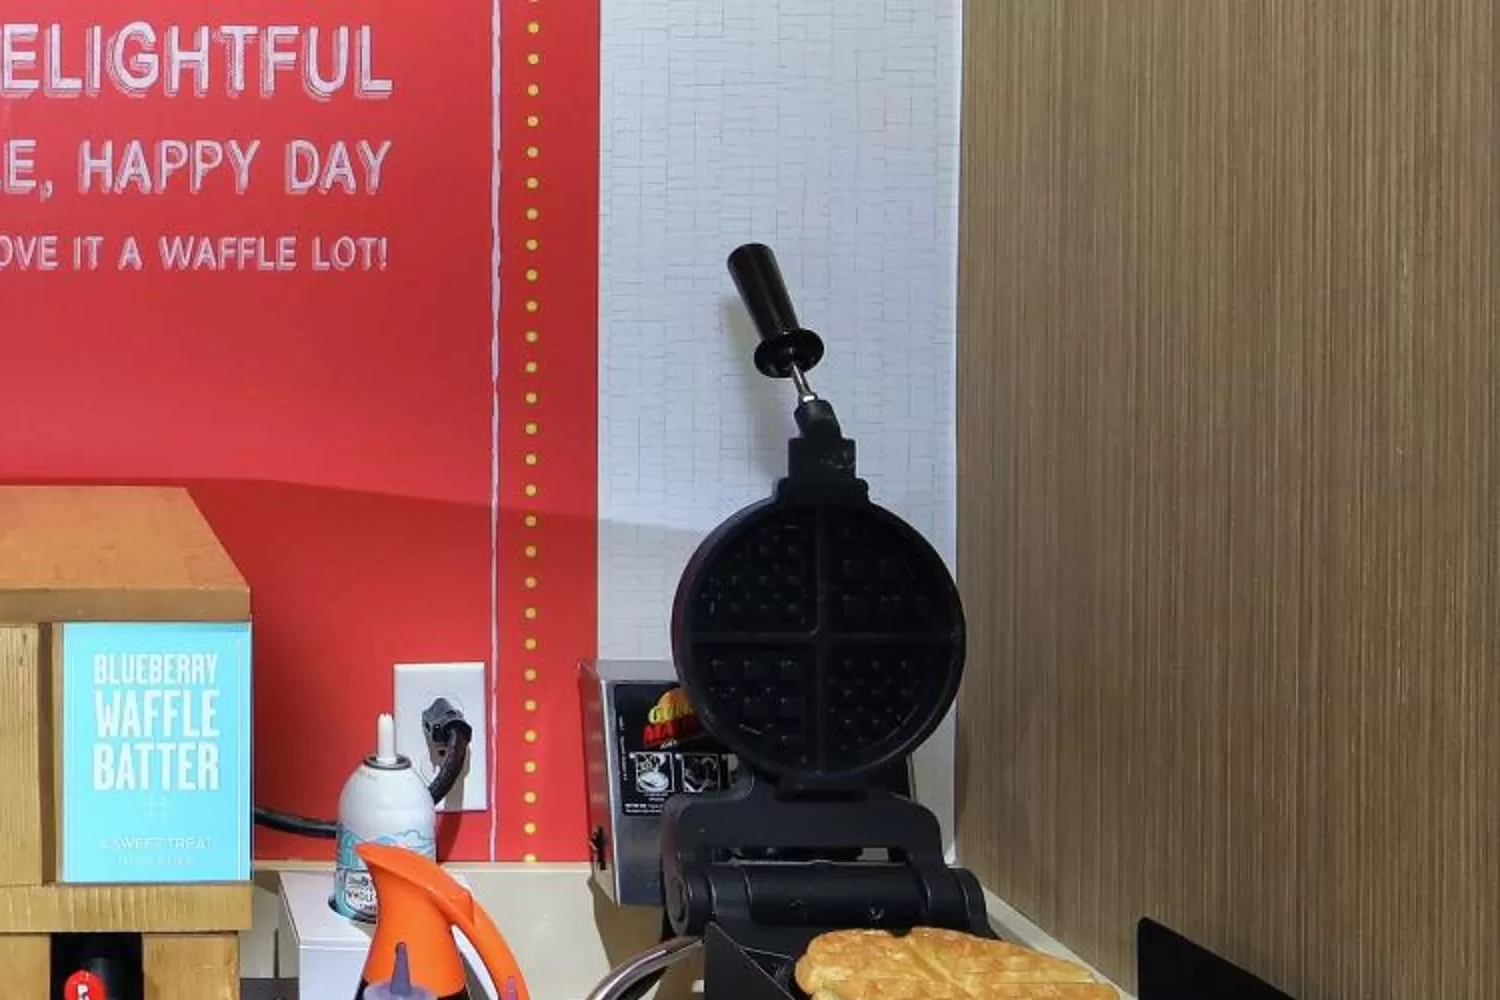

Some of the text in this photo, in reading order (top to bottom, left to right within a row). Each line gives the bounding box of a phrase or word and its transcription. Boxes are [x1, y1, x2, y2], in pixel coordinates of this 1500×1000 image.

[78, 137, 260, 195] HAPPY
[284, 138, 392, 195] DAY
[73, 235, 105, 271] IT
[118, 235, 143, 271] A
[159, 235, 297, 272] WAFFLE
[312, 235, 388, 272] LOT!
[93, 652, 219, 686] BLUEBERRY
[95, 689, 220, 739] WAFFLE
[93, 742, 220, 792] BATTER
